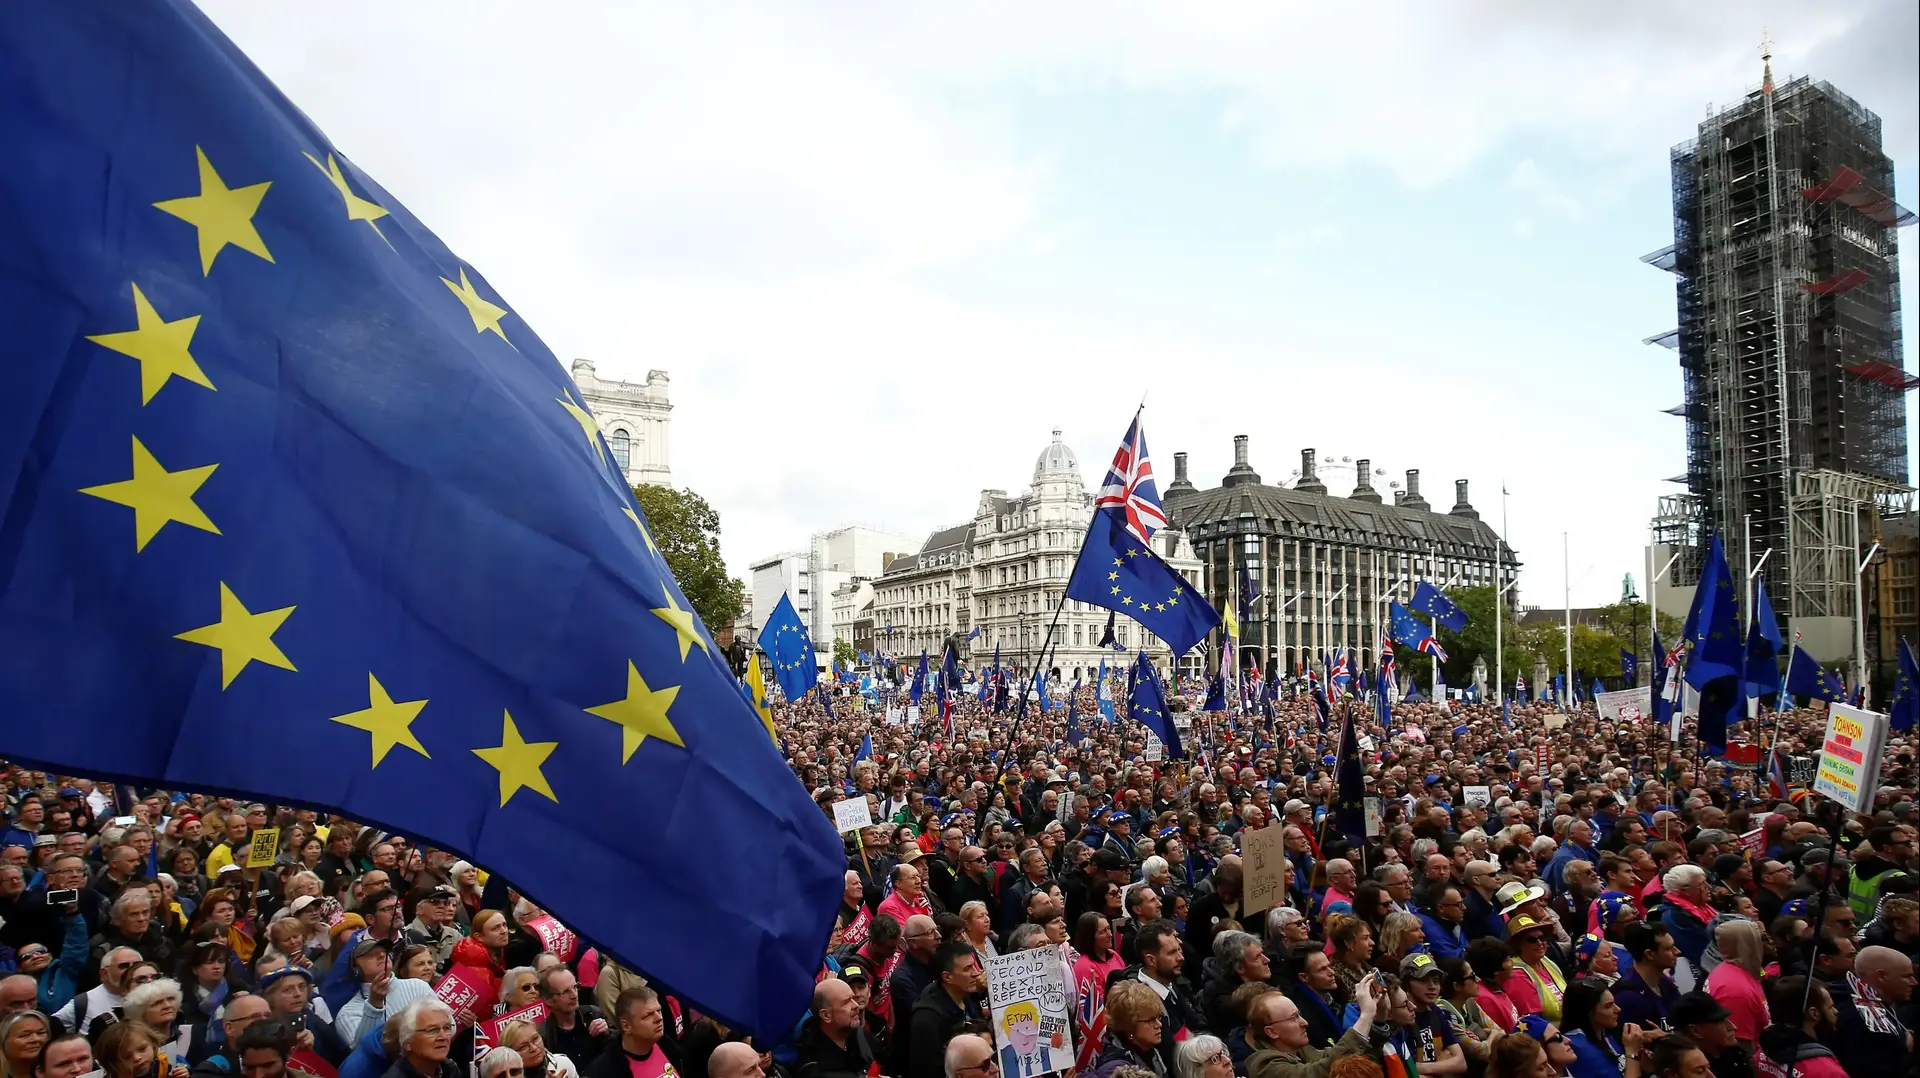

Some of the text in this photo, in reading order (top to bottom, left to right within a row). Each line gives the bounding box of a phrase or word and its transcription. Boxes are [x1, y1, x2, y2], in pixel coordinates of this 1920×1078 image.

[1833, 715, 1863, 739] JOHNSON
[1791, 759, 1813, 771] STOP
[1790, 769, 1816, 782] BREXIT
[252, 849, 272, 858] PEOPLE
[844, 914, 867, 941] TOGETHER
[991, 962, 1043, 981] SECOND
[992, 974, 1047, 993] BREXIT
[993, 982, 1063, 1003] REFERENDUM
[455, 987, 472, 1006] SAY
[1006, 1012, 1033, 1027] ETON
